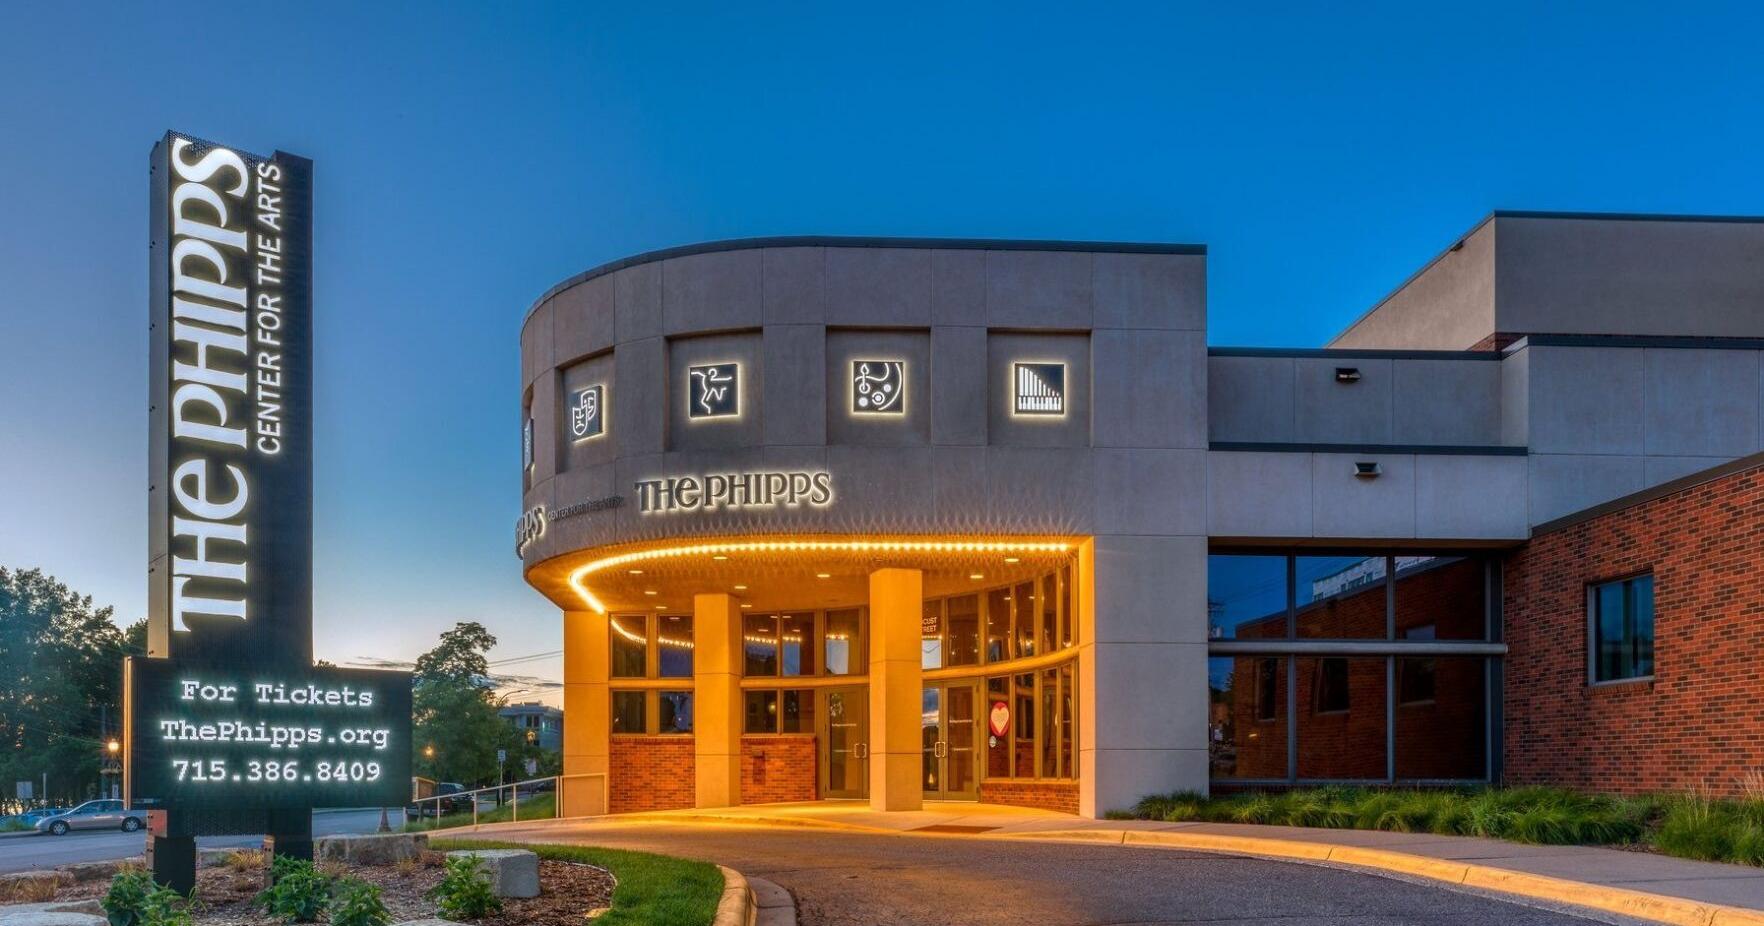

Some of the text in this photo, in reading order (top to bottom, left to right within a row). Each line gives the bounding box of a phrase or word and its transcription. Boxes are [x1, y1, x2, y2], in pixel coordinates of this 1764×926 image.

[172, 138, 249, 449] PHIPPS
[257, 162, 281, 454] CENTER FOR THE ARTS
[704, 472, 831, 507] PHIPPS
[181, 680, 373, 707] For Tickets
[161, 720, 389, 748] ThePhipps.org
[173, 760, 380, 782] 715.386.8409
